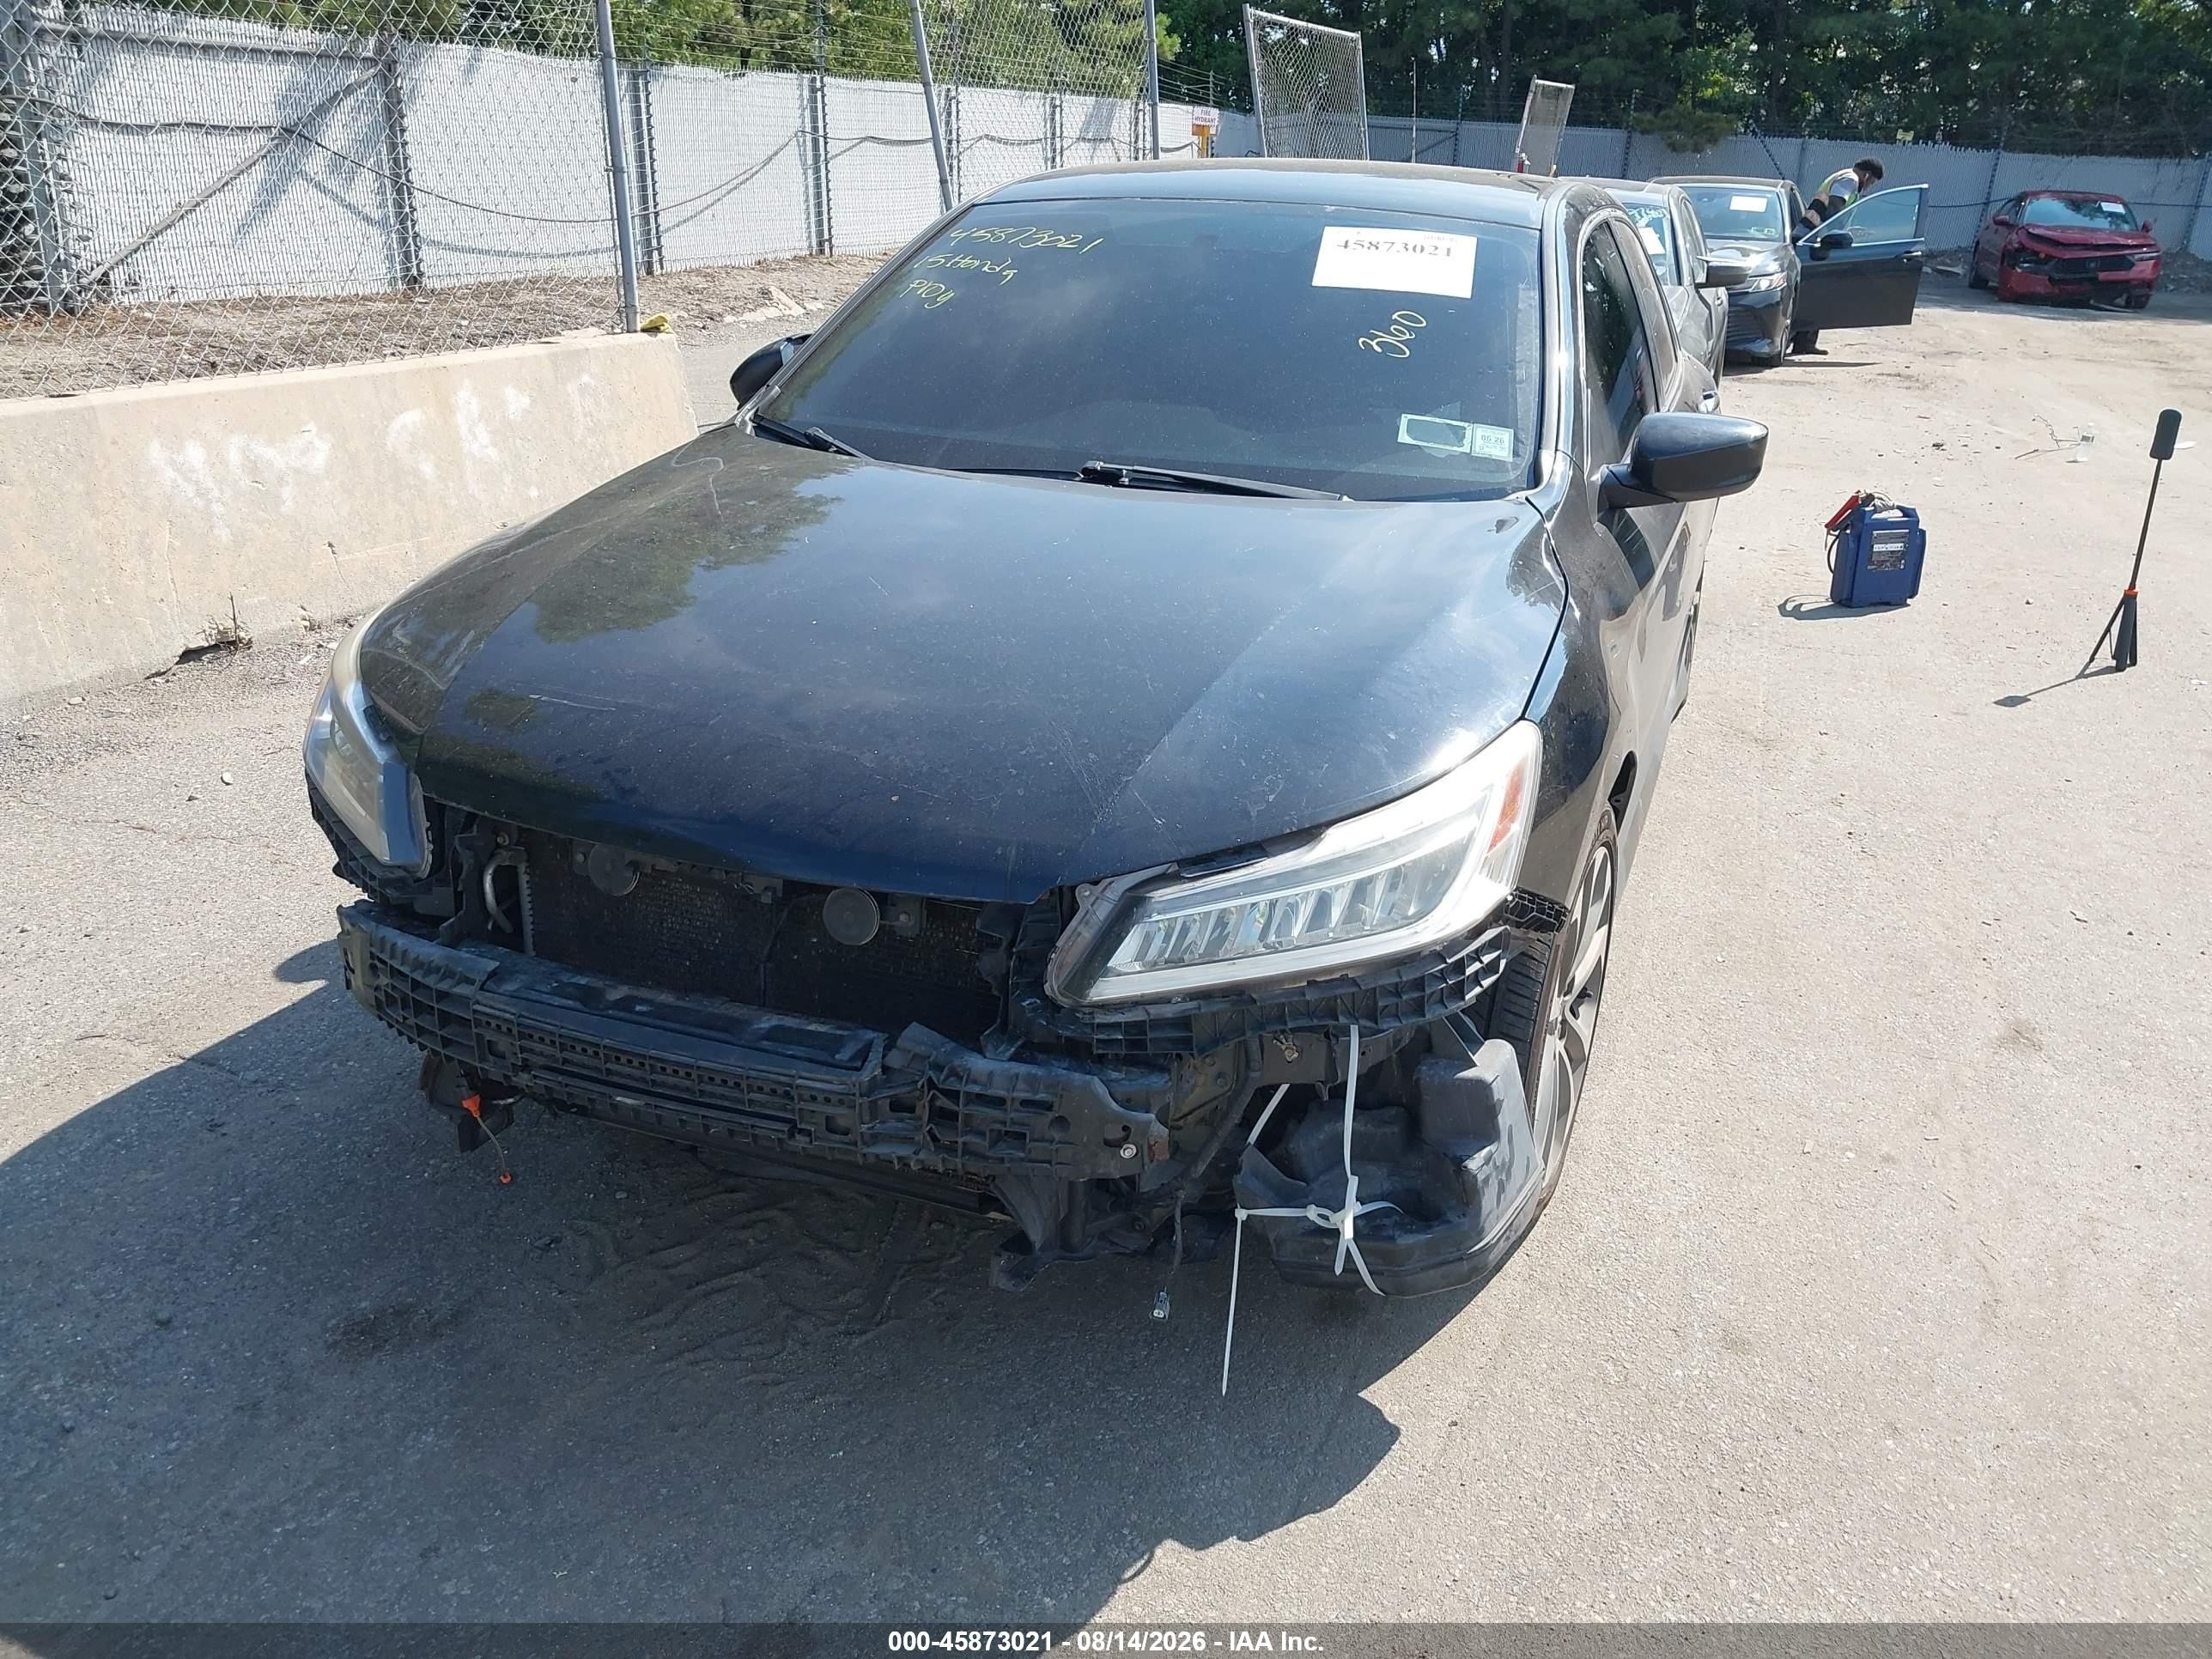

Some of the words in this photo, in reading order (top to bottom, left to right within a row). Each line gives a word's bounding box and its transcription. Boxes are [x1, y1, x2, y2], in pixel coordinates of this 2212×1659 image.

[950, 227, 1104, 255] 45873021
[1336, 239, 1454, 258] 45873021
[1358, 310, 1427, 358] 360
